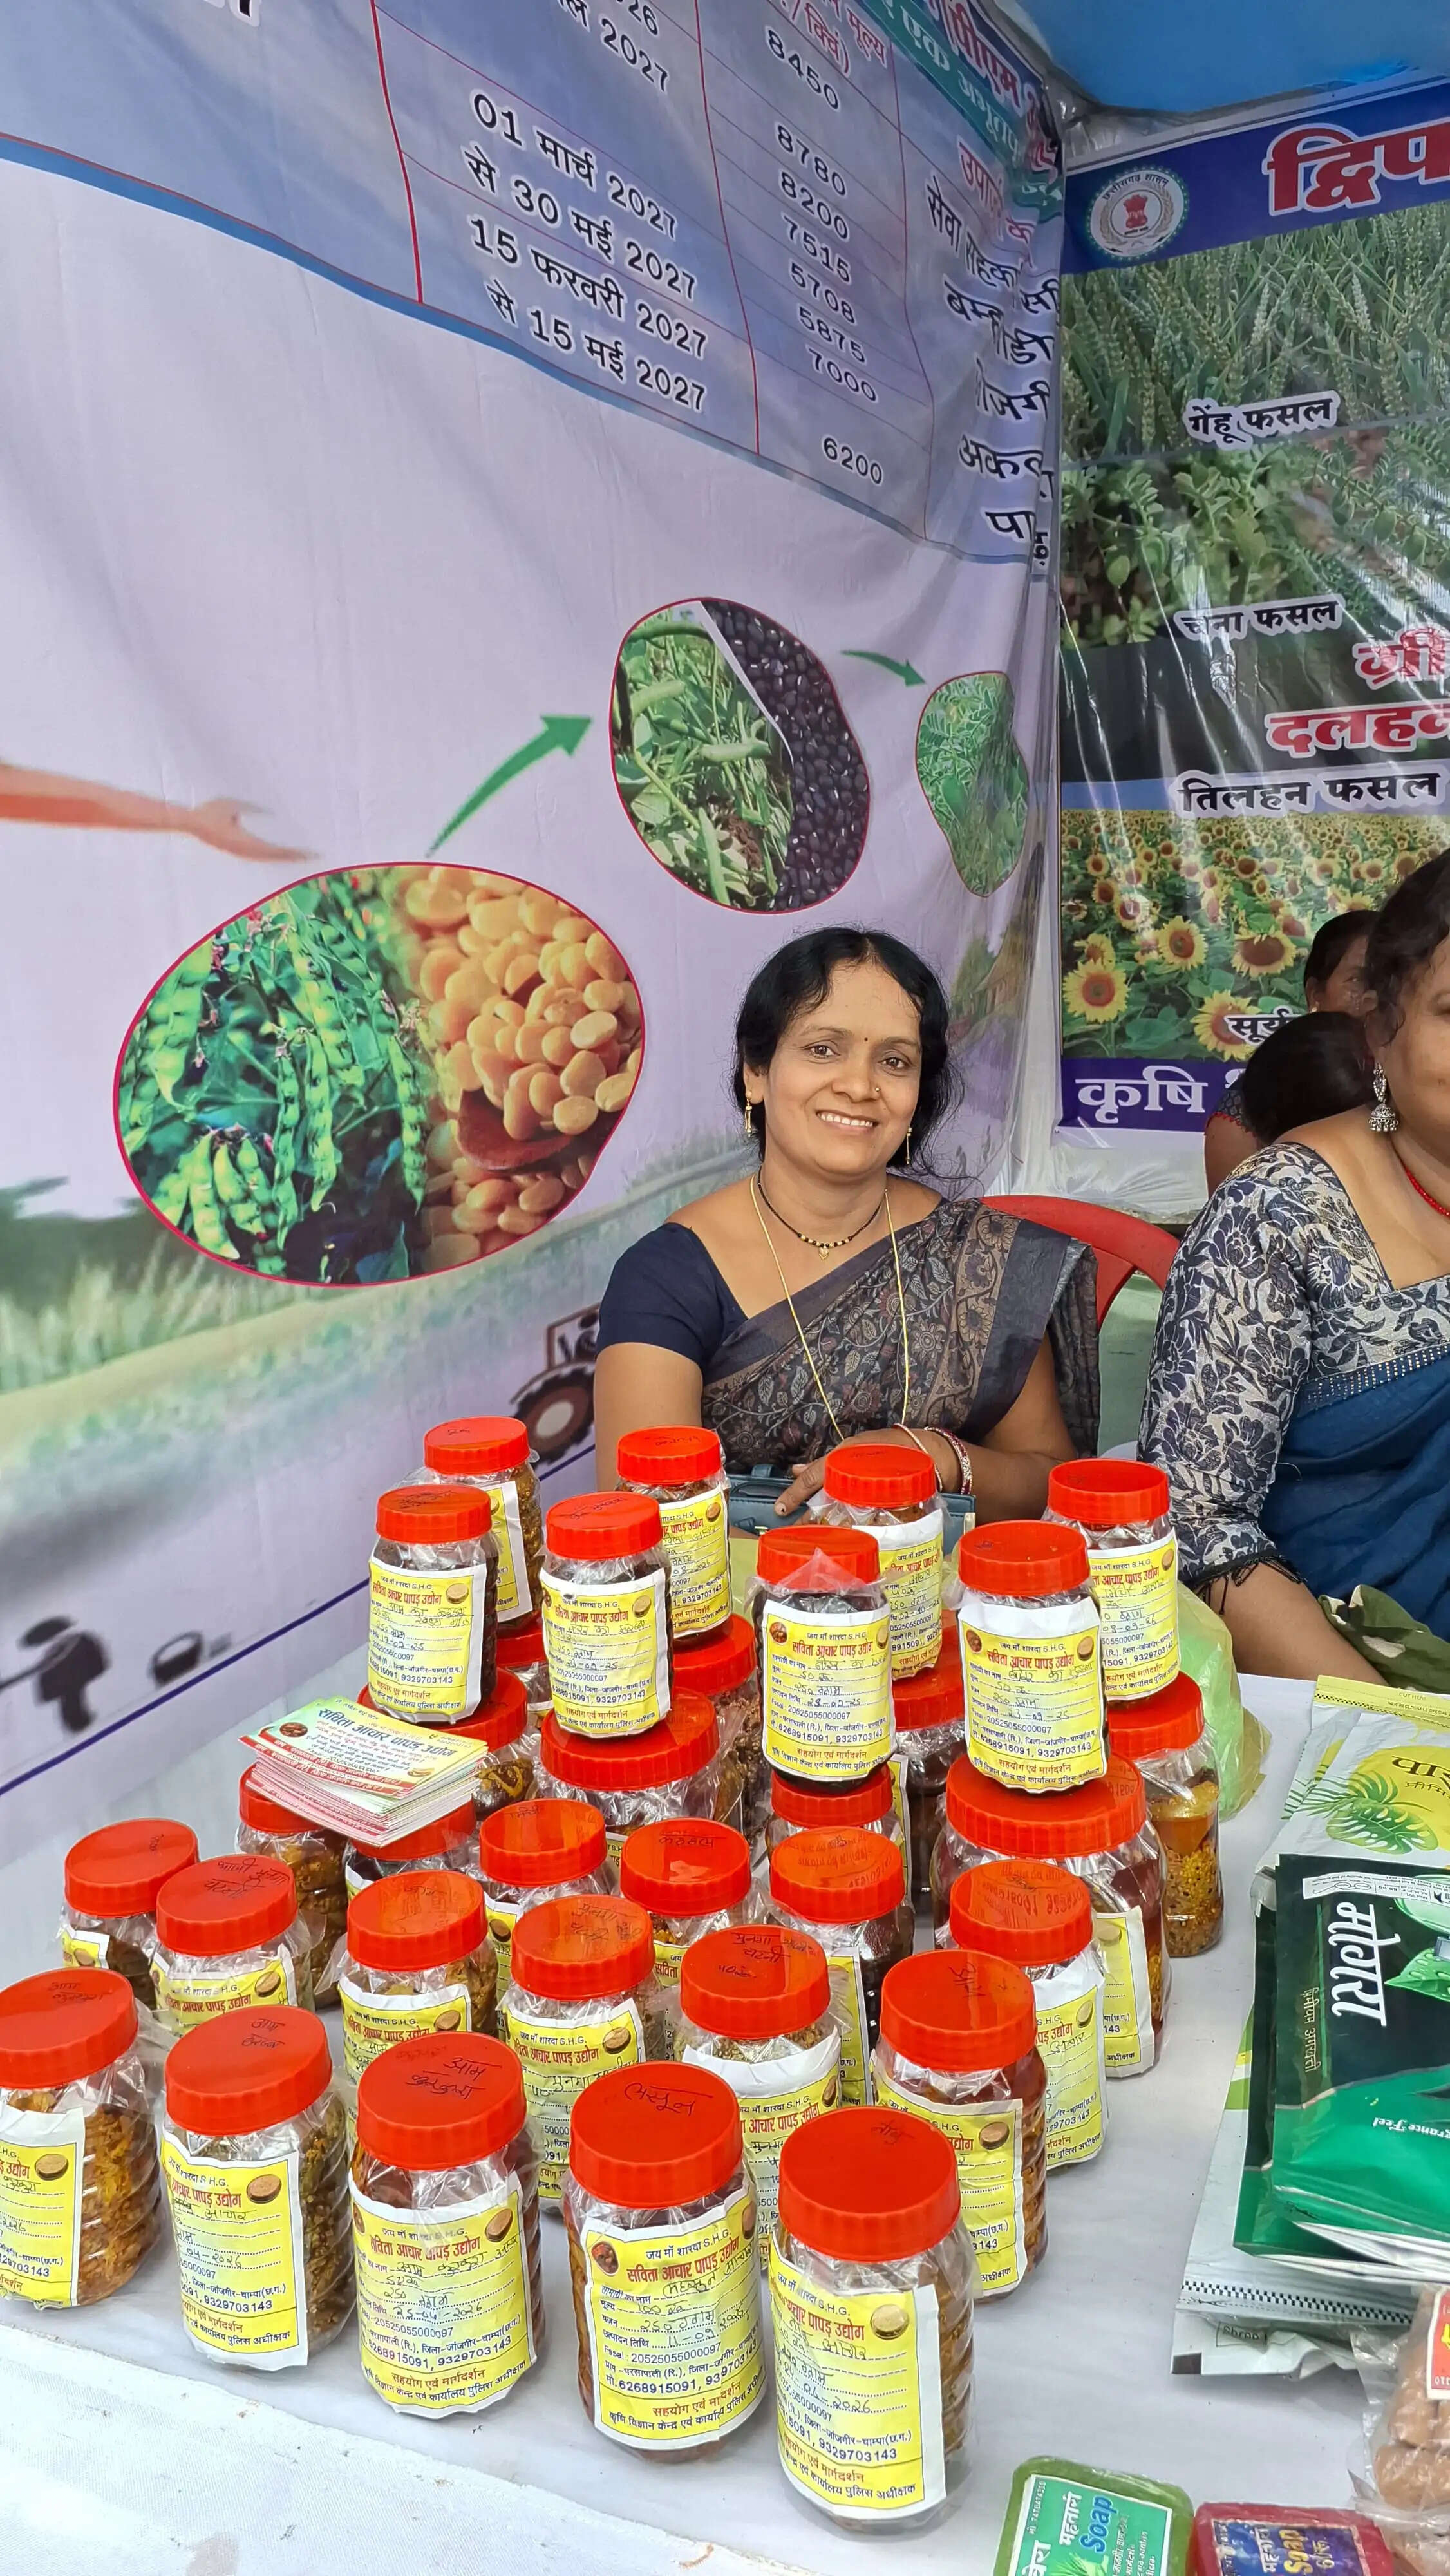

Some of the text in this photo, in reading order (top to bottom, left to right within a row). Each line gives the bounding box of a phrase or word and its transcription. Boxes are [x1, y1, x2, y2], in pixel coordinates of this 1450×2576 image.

[601, 18, 668, 91] 2027
[768, 31, 838, 109] 8450
[473, 94, 677, 239] 01 मार्च 2027
[777, 124, 846, 196] 8780
[781, 171, 850, 241] 8200
[927, 175, 962, 252] सेवा
[466, 147, 695, 299] से 30 मई 2027
[784, 216, 851, 283] 7515
[471, 220, 707, 358] 15 फरवरी 2027
[791, 263, 855, 324] 5708
[485, 281, 706, 411] से 15 मई 2027
[799, 306, 866, 363] 5875
[807, 348, 877, 402] 7000
[1243, 398, 1335, 433] फसल
[824, 437, 882, 485] 6200
[1253, 600, 1339, 630] फसल
[1178, 772, 1441, 812] तिलहन फसल
[1075, 1066, 1208, 1124] कृषि
[792, 1640, 814, 1656] सविता
[401, 1674, 453, 1683] 9329703143
[319, 1708, 355, 1728] सविता
[1328, 1902, 1402, 2027] मोगरा
[1408, 2123, 1450, 2140] grance
[215, 2188, 241, 2208] उद्योग
[397, 2243, 422, 2261] आचार
[452, 2235, 480, 2255] उद्योग
[626, 2264, 658, 2282] सविता
[662, 2262, 692, 2280] आचार
[720, 2236, 740, 2262] उद्योग
[646, 2250, 661, 2260] जय
[678, 2242, 701, 2255] शारदा
[704, 2229, 731, 2247] S.H.G.
[205, 2295, 272, 2312] 9329703143
[601, 2300, 615, 2311] मूल्य
[636, 2295, 651, 2304] नाम
[818, 2299, 851, 2316] S.H.G.
[603, 2329, 649, 2348] उत्पादन तिथि
[808, 2311, 865, 2340] पापड़ उद्योग
[437, 2336, 511, 2366] 9329703143
[391, 2369, 485, 2391] सहयोग एवं मार्गदर्शन
[430, 2389, 466, 2401] कार्यालय
[469, 2381, 493, 2398] पुलिस
[609, 2410, 626, 2424] कृषि
[629, 2416, 655, 2430] विज्ञान
[658, 2421, 677, 2431] केन्द्र
[681, 2416, 692, 2430] एवं
[652, 2398, 706, 2417] सहयोग एवं
[819, 2438, 897, 2461] 9329703143
[811, 2473, 842, 2494] कार्यालय
[845, 2487, 872, 2497] पुलिस
[822, 2465, 864, 2482] मार्गदर्शन
[1079, 2496, 1118, 2554] Soap
[1282, 2530, 1313, 2574] Soap
